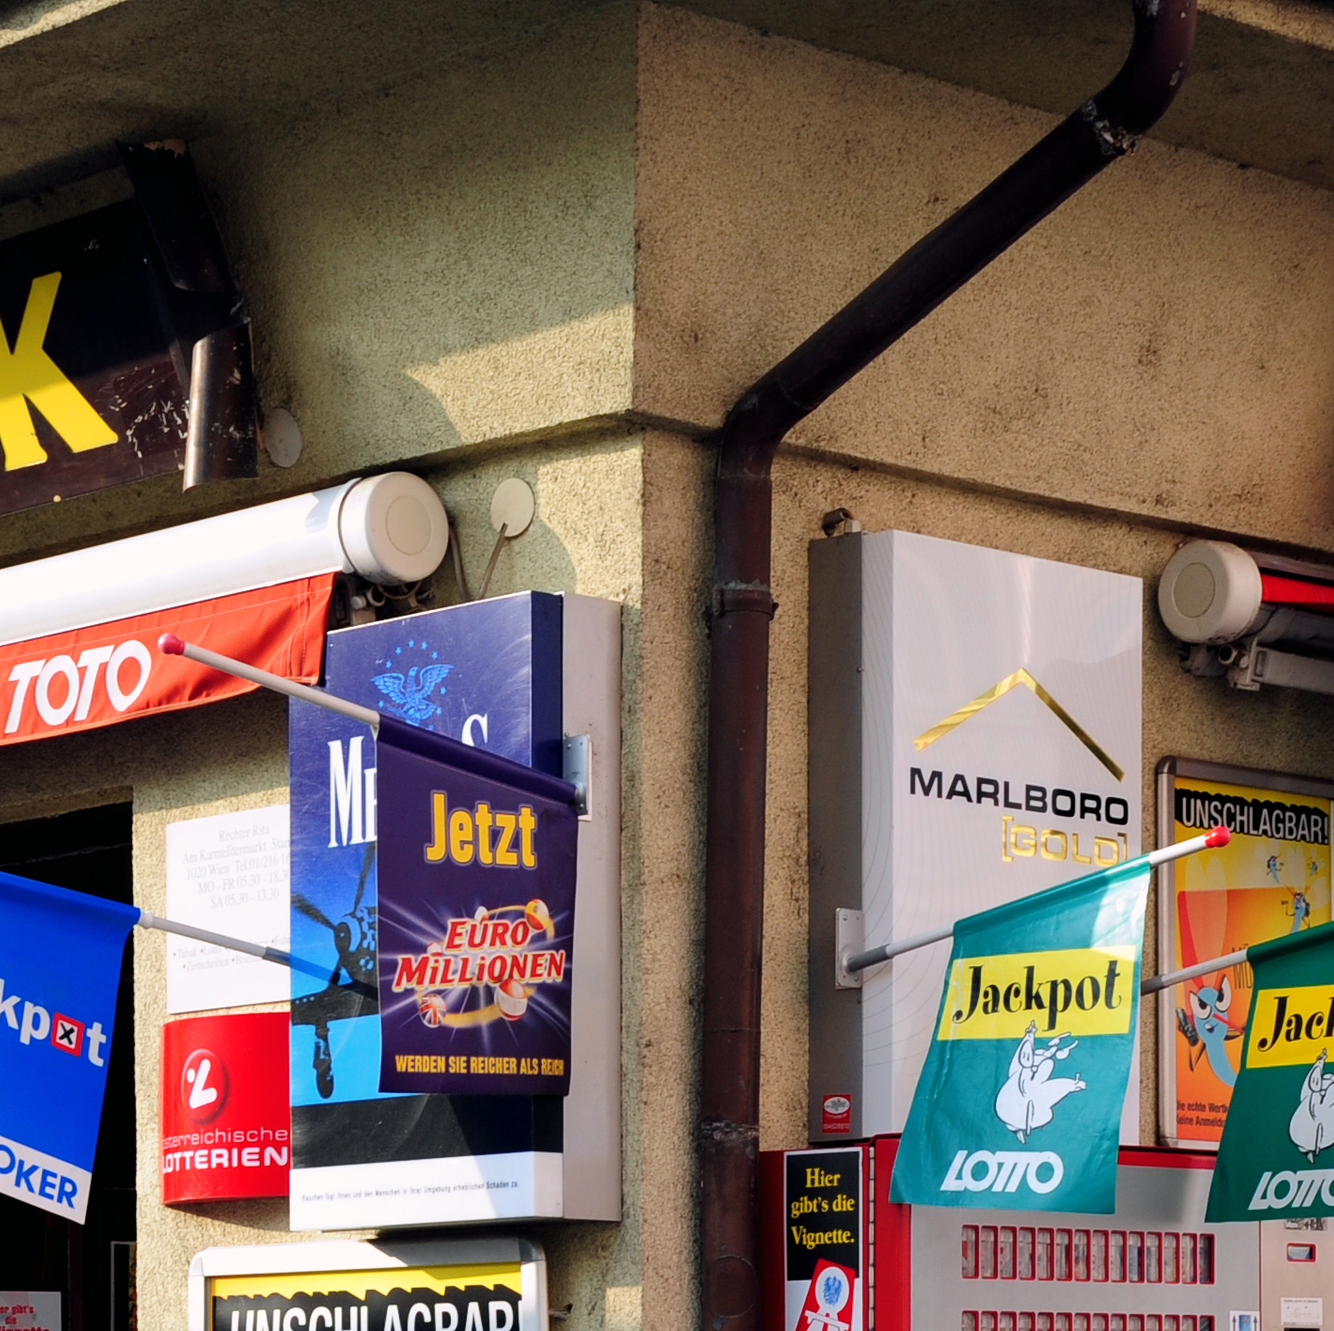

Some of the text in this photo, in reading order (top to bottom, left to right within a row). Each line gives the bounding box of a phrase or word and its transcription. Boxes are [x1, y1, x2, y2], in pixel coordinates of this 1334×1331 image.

[4, 640, 152, 735] TOTO
[910, 766, 1129, 826] MARLBORO
[425, 791, 538, 870] Jetzt
[1181, 795, 1329, 846] UNSCHLAGBAR!
[444, 918, 530, 954] EURO
[952, 958, 1122, 1032] Jackpot
[395, 1055, 446, 1073] WERDEN
[448, 1056, 468, 1074] SIE
[470, 1056, 518, 1075] REICHER
[520, 1057, 539, 1076] ALS
[805, 1167, 841, 1189] Hier
[940, 1149, 1064, 1195] LOTTO
[790, 1197, 856, 1218] gibt's die
[790, 1225, 855, 1250] Vignette.
